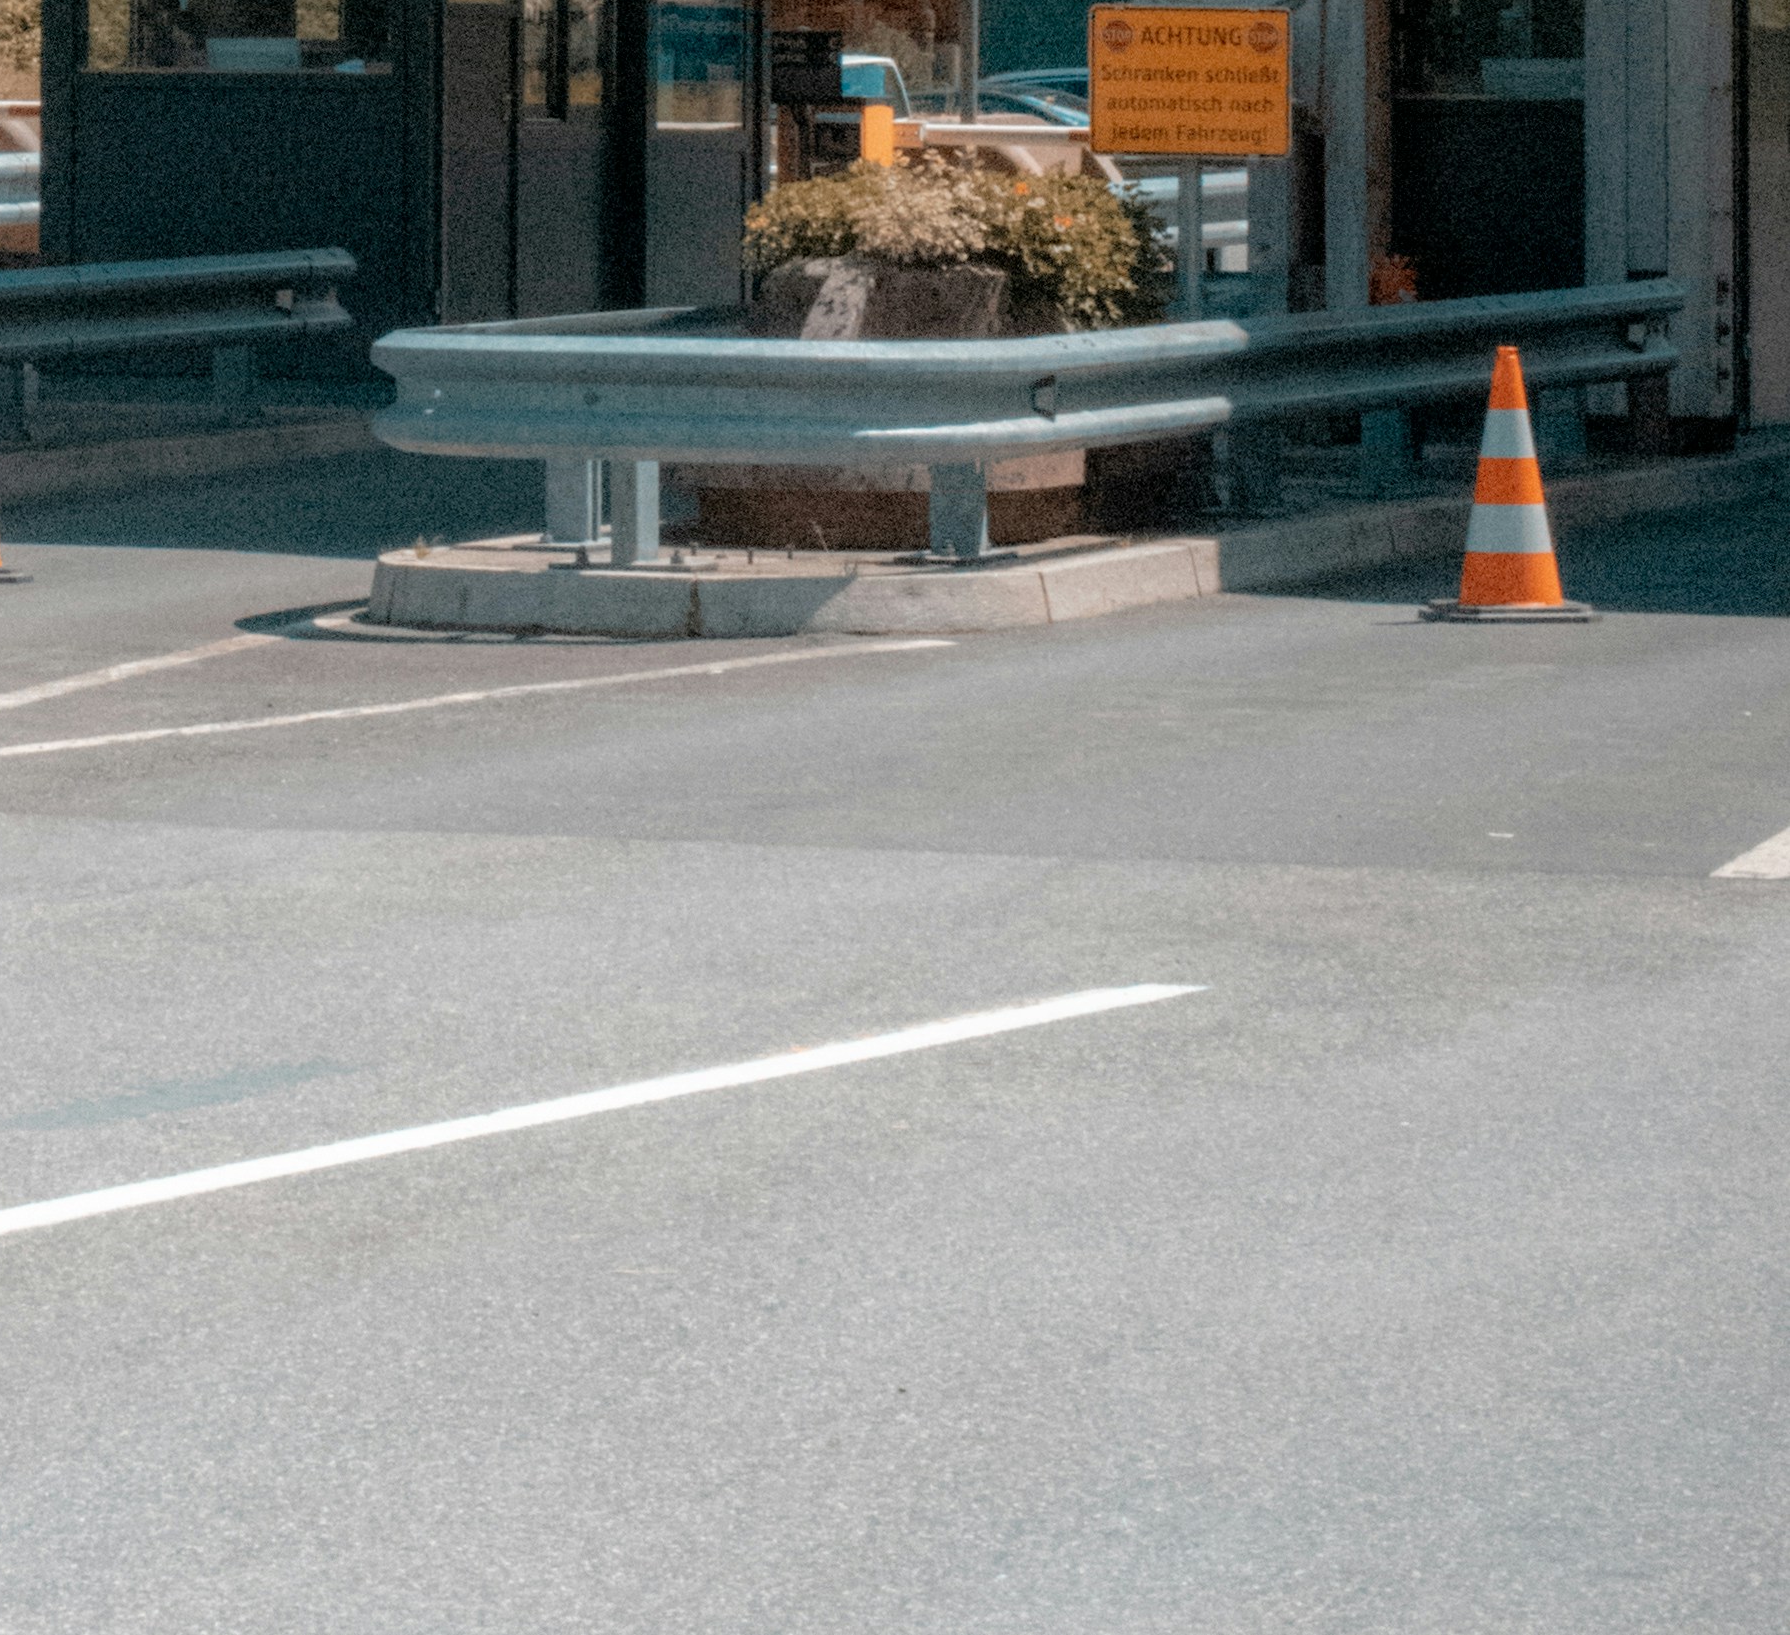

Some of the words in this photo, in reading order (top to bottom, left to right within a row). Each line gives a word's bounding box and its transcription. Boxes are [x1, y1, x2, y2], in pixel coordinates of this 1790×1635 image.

[1140, 26, 1242, 46] ACHTUNG
[1101, 63, 1198, 83] Schranken
[1205, 65, 1280, 84] schließt
[1107, 96, 1222, 112] automatisch
[1230, 97, 1275, 113] nach
[1110, 124, 1169, 144] jedem
[1176, 124, 1268, 145] Fahrzeug!
